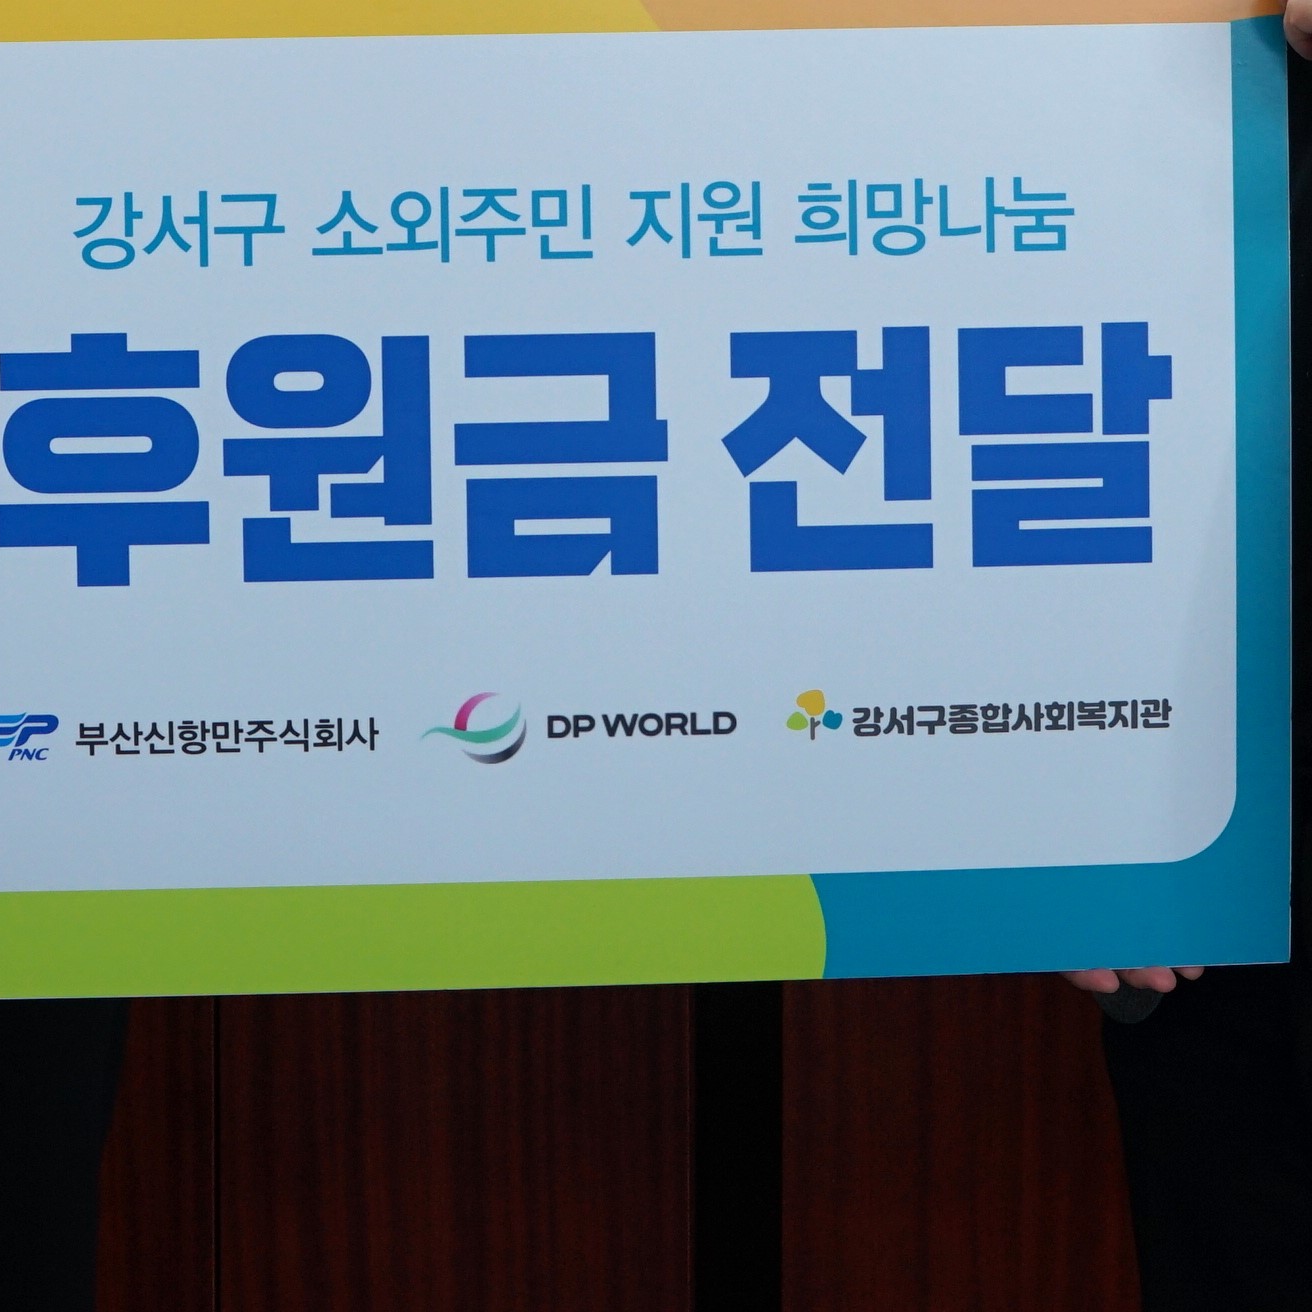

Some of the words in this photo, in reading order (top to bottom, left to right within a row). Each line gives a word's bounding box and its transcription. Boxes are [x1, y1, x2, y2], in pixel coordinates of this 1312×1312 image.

[72, 188, 287, 270] 강서구
[311, 184, 593, 263] 소외주민
[626, 180, 761, 258] 지원
[794, 175, 1076, 255] 희망나눔
[721, 320, 1174, 575] 전달
[75, 717, 380, 756] 부산신항만주식회사
[546, 710, 599, 740] DP
[604, 709, 738, 740] WORLD
[851, 696, 1173, 740] 강서구종합사회복지관
[7, 748, 50, 761] PNC
